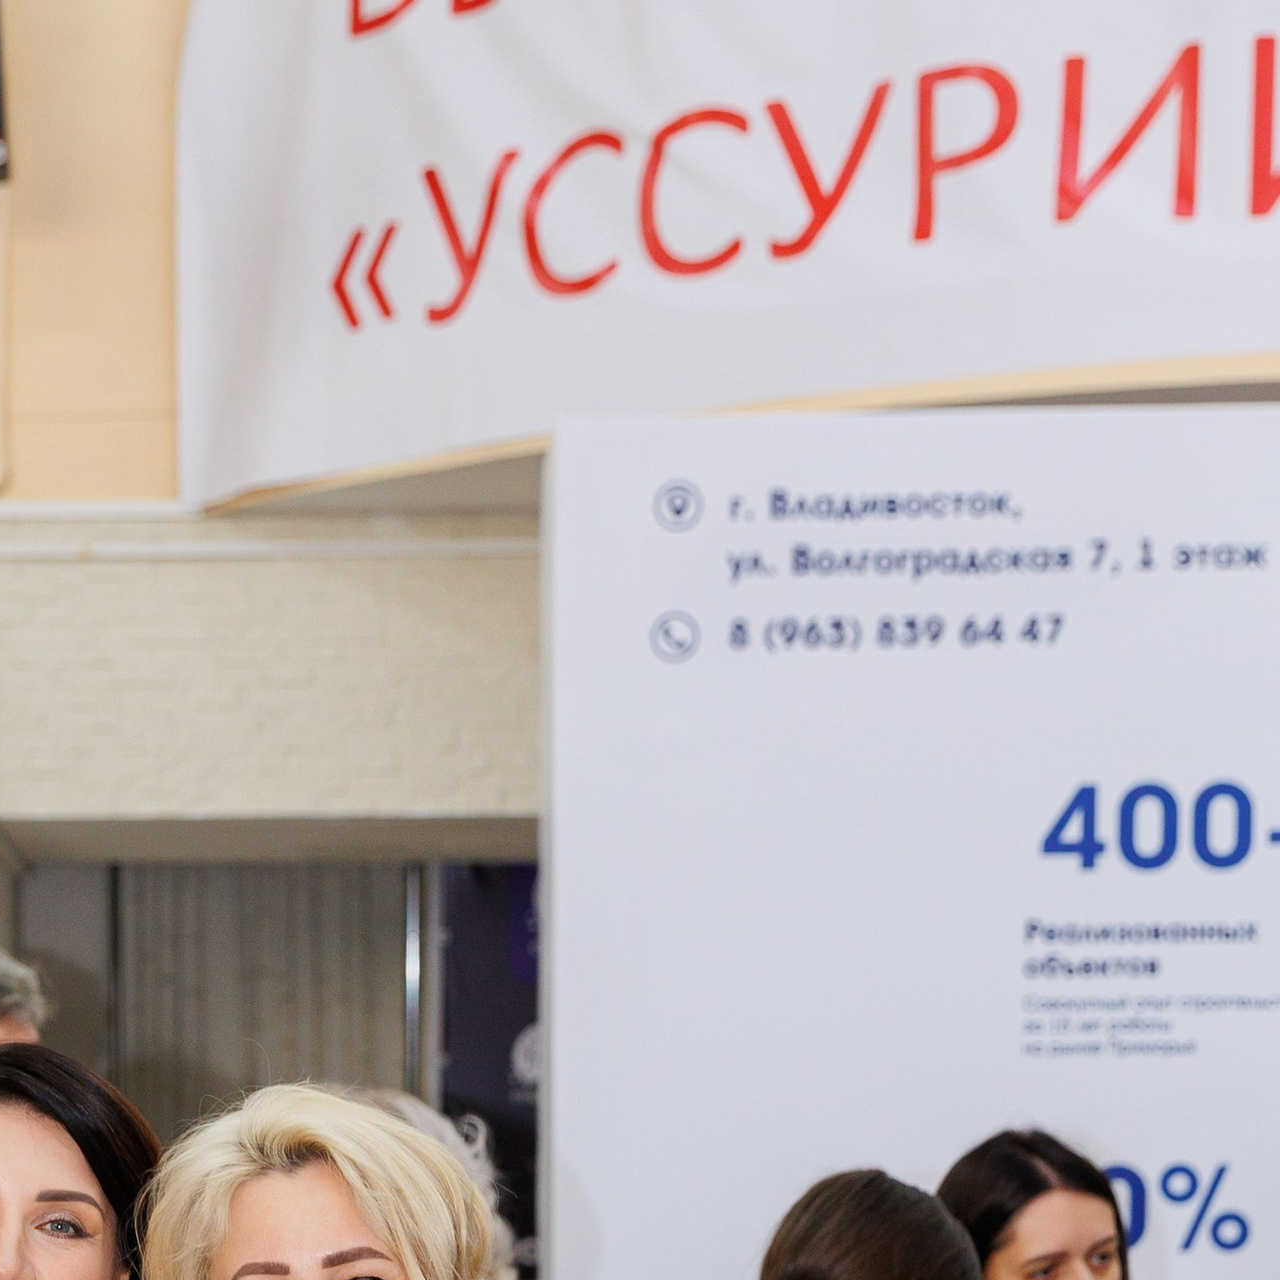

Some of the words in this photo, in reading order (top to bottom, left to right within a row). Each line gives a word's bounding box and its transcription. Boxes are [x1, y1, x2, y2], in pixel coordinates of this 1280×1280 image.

[329, 35, 1280, 330] «УССУРИ
[769, 489, 1021, 521] Владивосток,
[728, 553, 774, 584] ул.
[791, 544, 1070, 581] Волгоградская
[1138, 537, 1155, 571] 1
[1174, 543, 1267, 571] этаж
[730, 617, 749, 648] 8
[764, 615, 862, 652] (963)
[877, 614, 945, 648] 839
[959, 614, 1004, 647] 64
[1019, 613, 1065, 646] 47
[1041, 782, 1280, 870] 400
